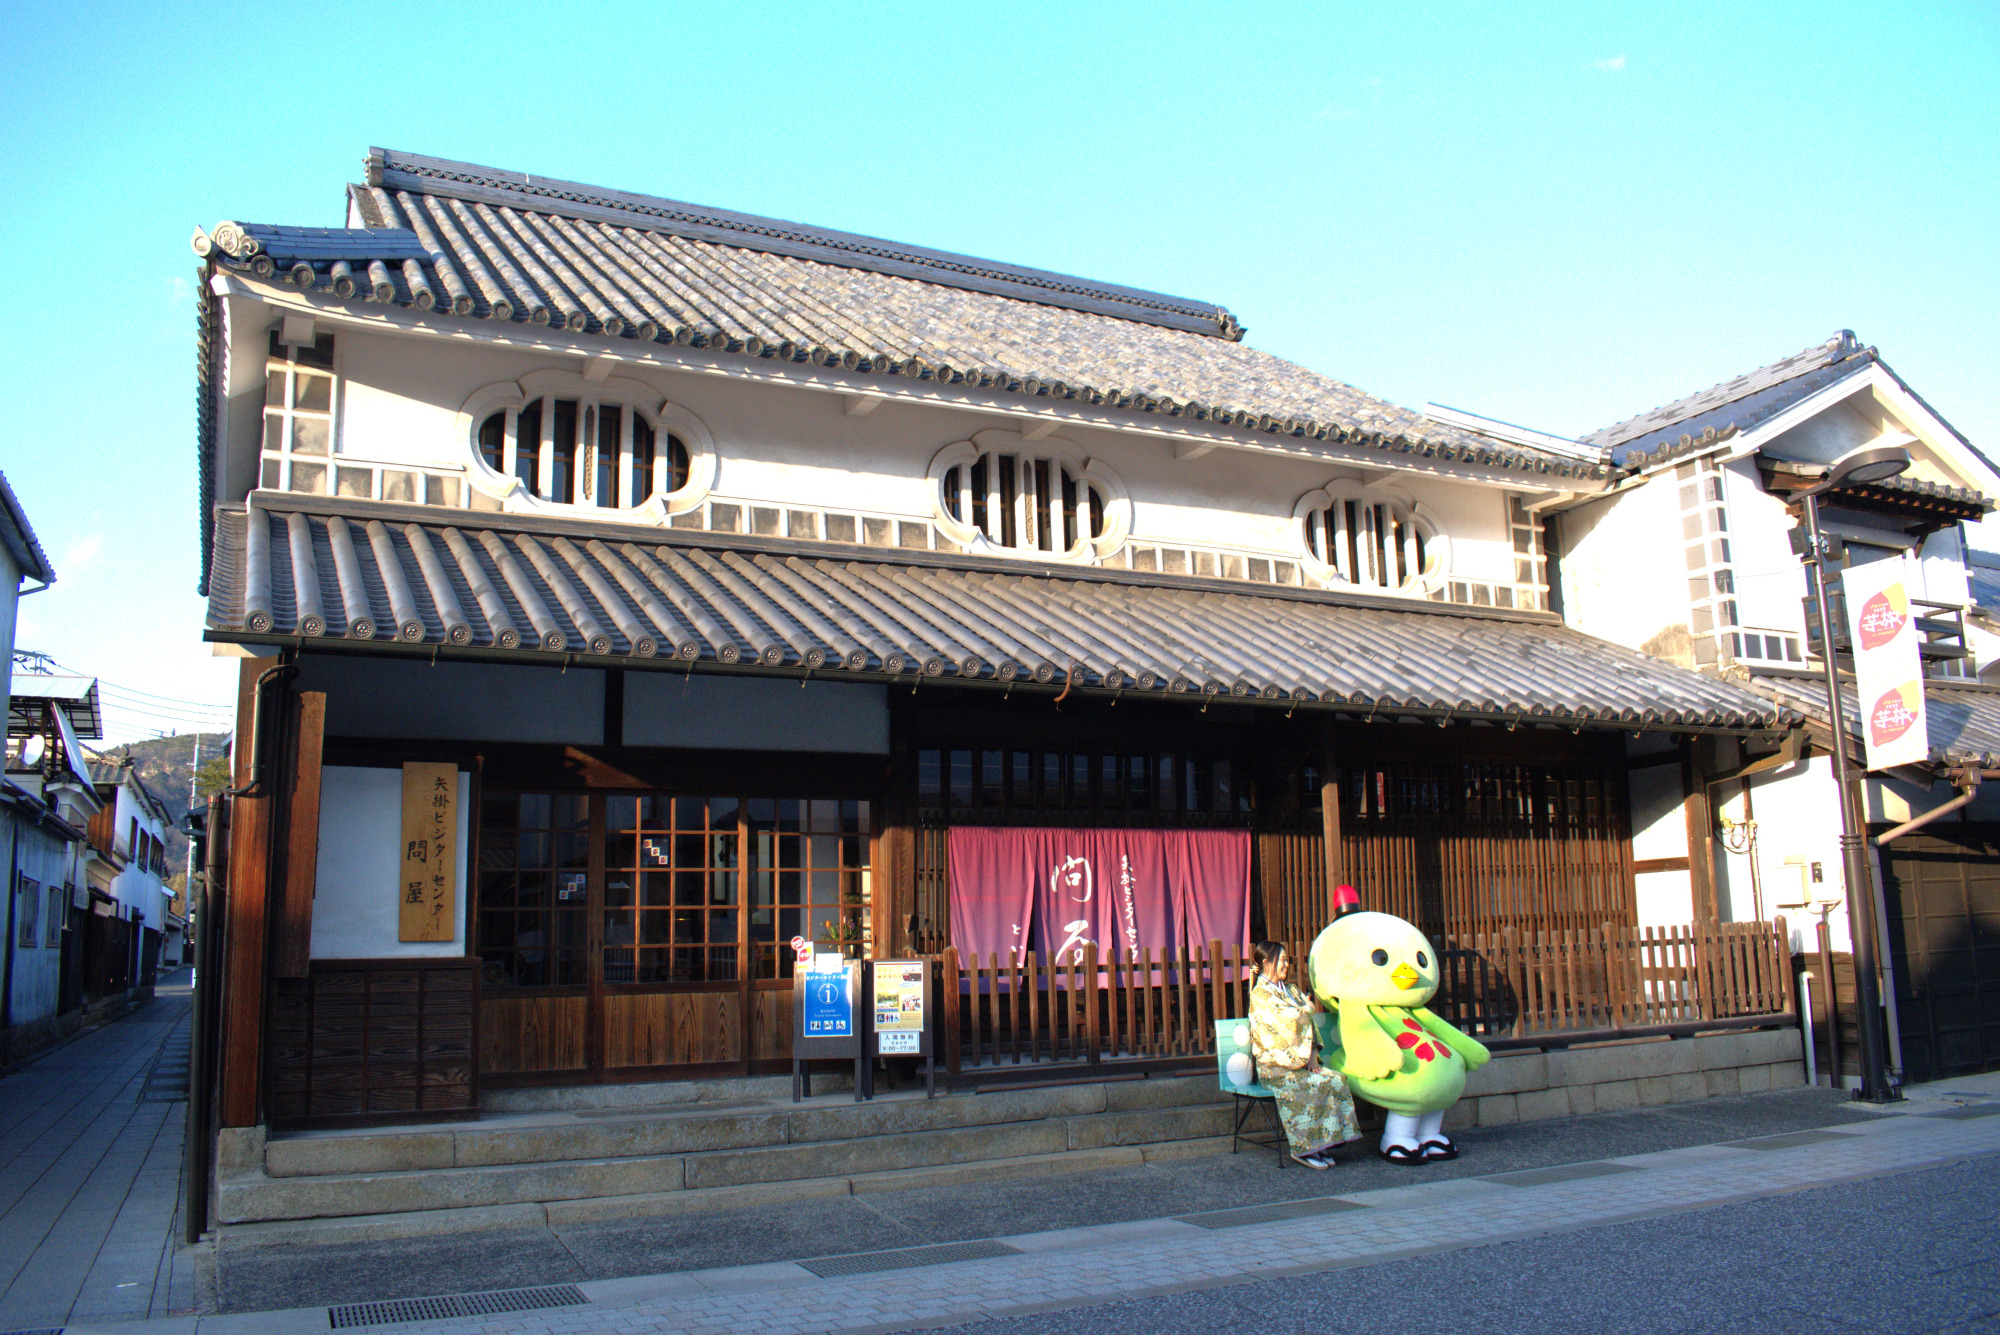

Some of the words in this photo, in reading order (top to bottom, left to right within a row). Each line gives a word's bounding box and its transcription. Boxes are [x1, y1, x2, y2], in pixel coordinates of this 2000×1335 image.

[1863, 610, 1904, 632] 芋旅
[1875, 706, 1914, 728] 芋旅
[406, 840, 428, 904] 問屋
[433, 777, 450, 930] 矢掛ビジターセンター
